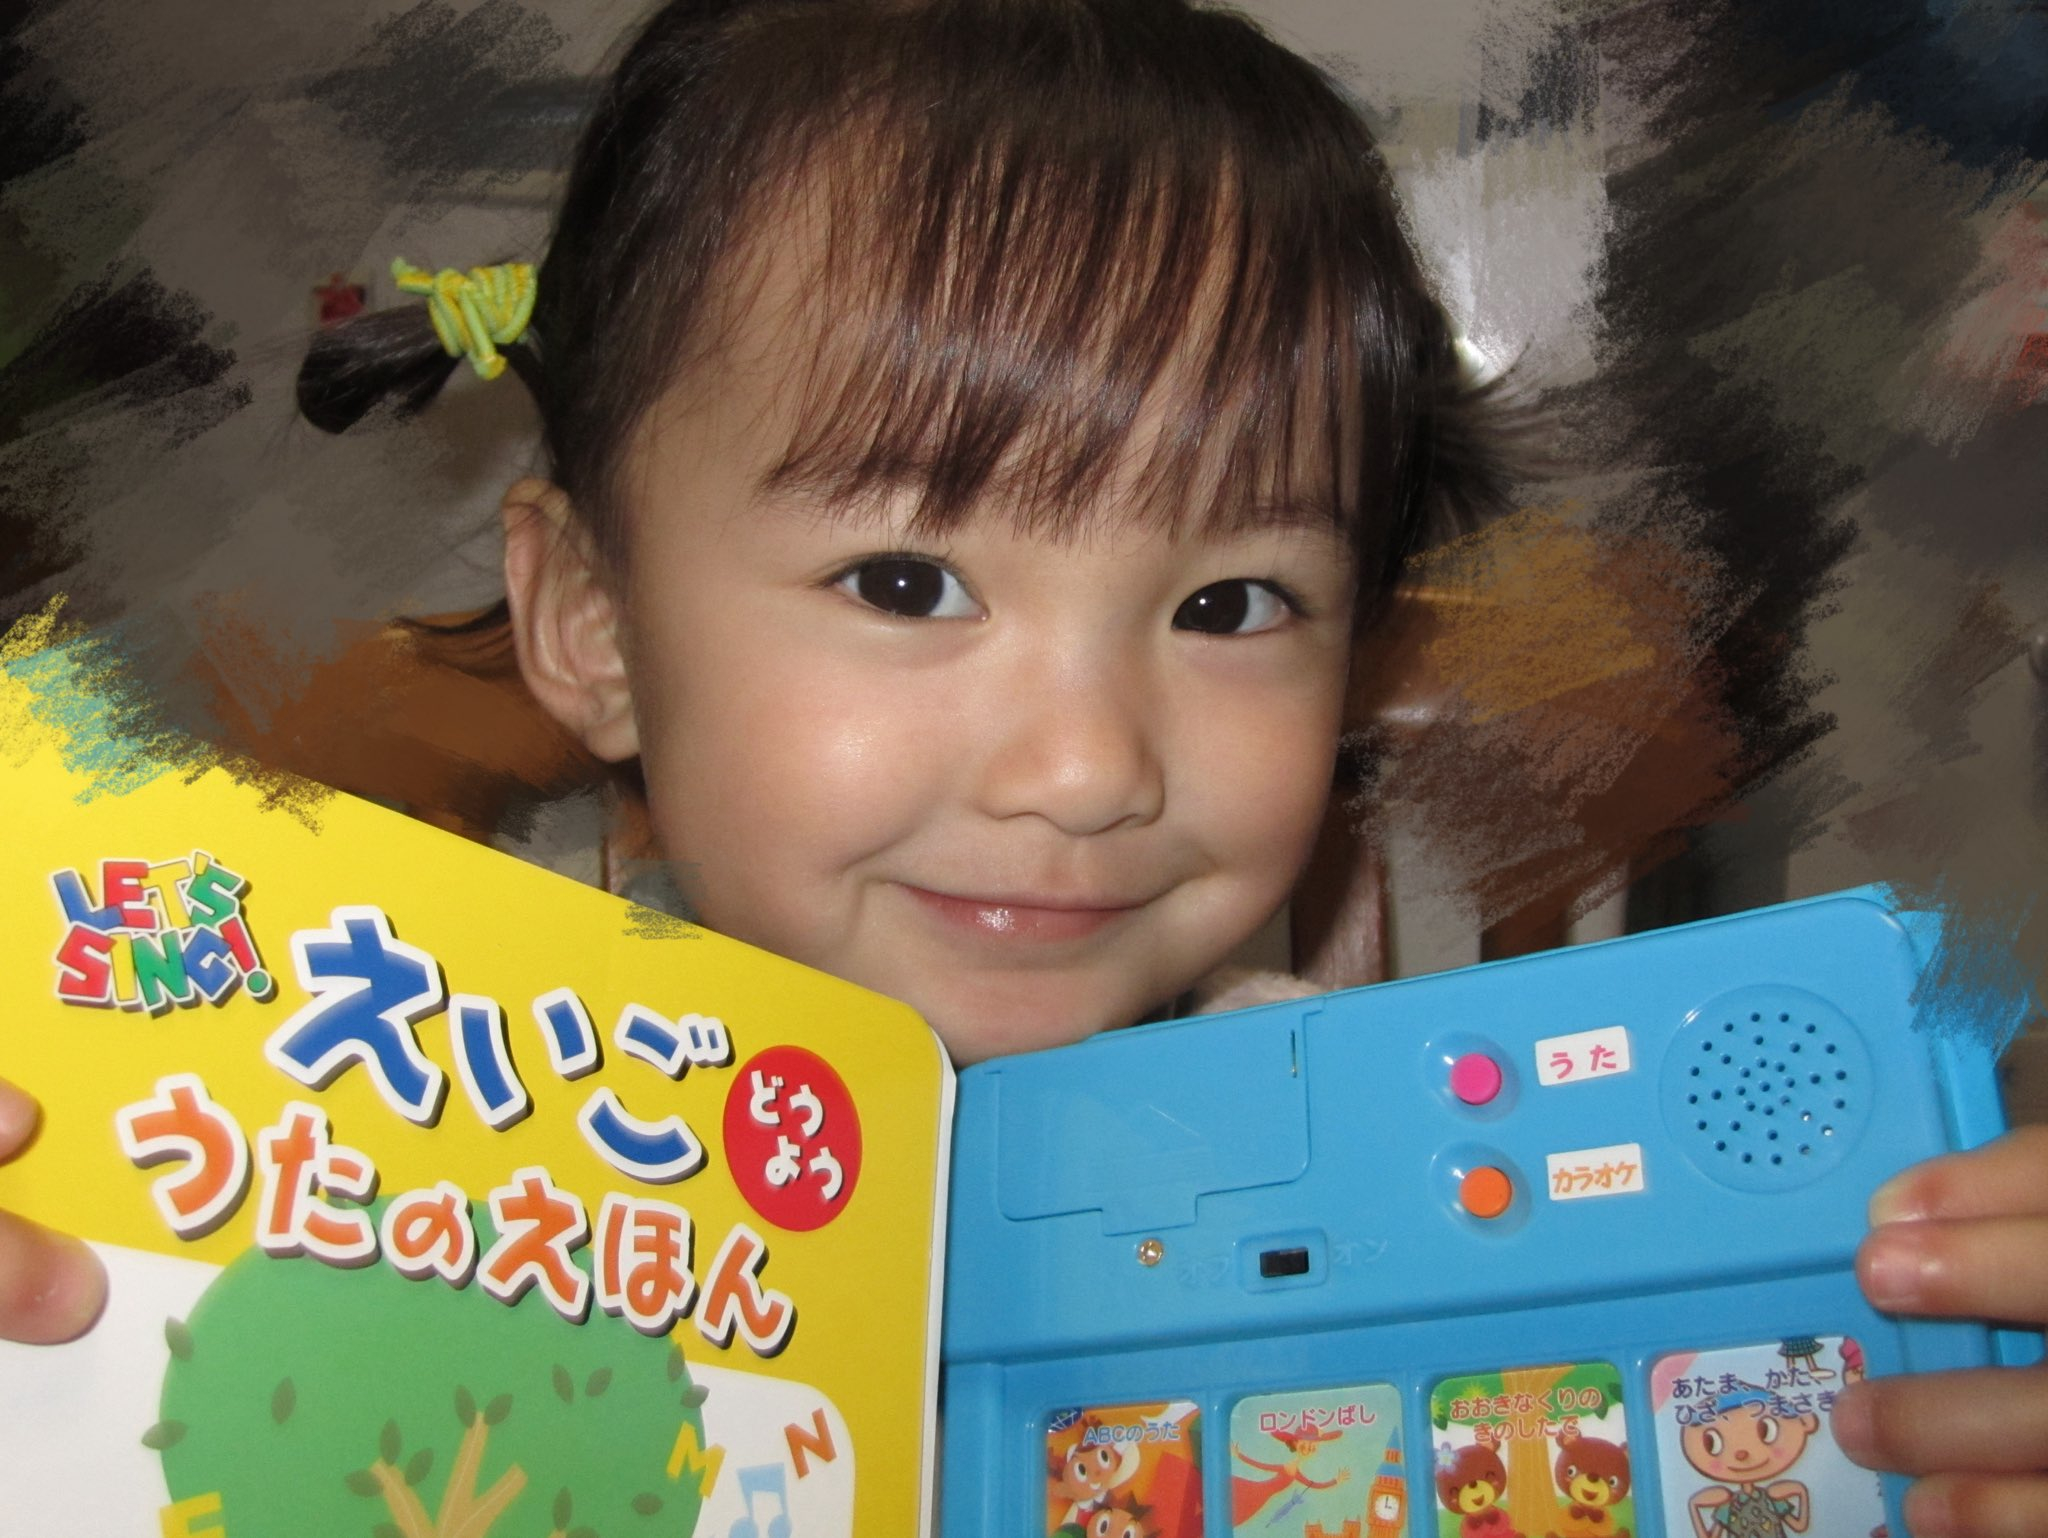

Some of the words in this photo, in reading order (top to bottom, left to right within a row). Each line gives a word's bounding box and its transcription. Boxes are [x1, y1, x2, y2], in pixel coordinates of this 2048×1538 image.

[50, 850, 246, 932] LET'S
[54, 915, 273, 1013] SING!
[266, 906, 732, 1183] えいご
[1549, 1044, 1618, 1079] うた
[749, 1069, 825, 1138] どう
[1553, 1160, 1638, 1194] カラオケ
[117, 1074, 796, 1356] うたのえほん
[1259, 1404, 1376, 1432] ロンドンばし
[1450, 1387, 1602, 1420] おおきなくりの
[1083, 1421, 1181, 1445] ABCのうた
[1474, 1415, 1580, 1442] きのしたで
